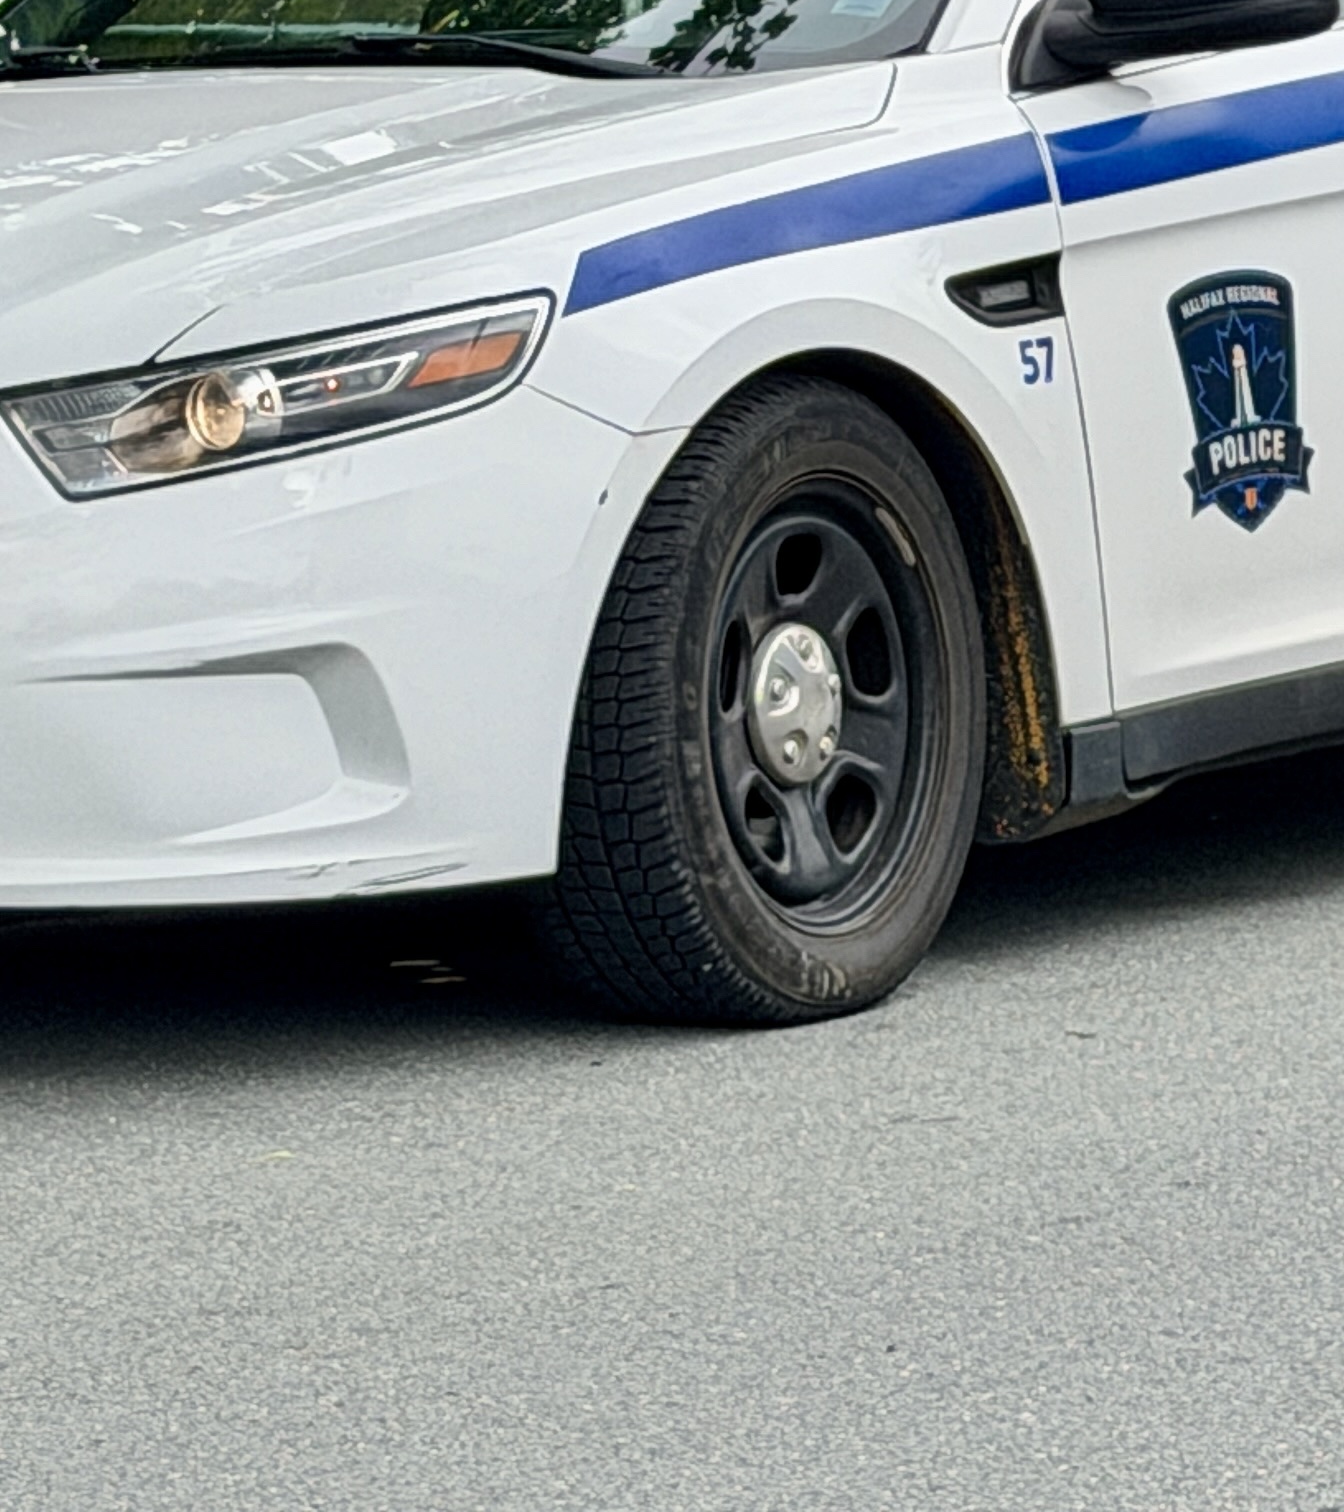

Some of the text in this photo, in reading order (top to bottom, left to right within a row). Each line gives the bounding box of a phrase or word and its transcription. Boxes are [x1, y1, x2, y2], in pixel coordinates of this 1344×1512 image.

[1179, 288, 1226, 319] HALIFAX
[1018, 335, 1054, 385] 57
[1208, 427, 1286, 476] POLICE
